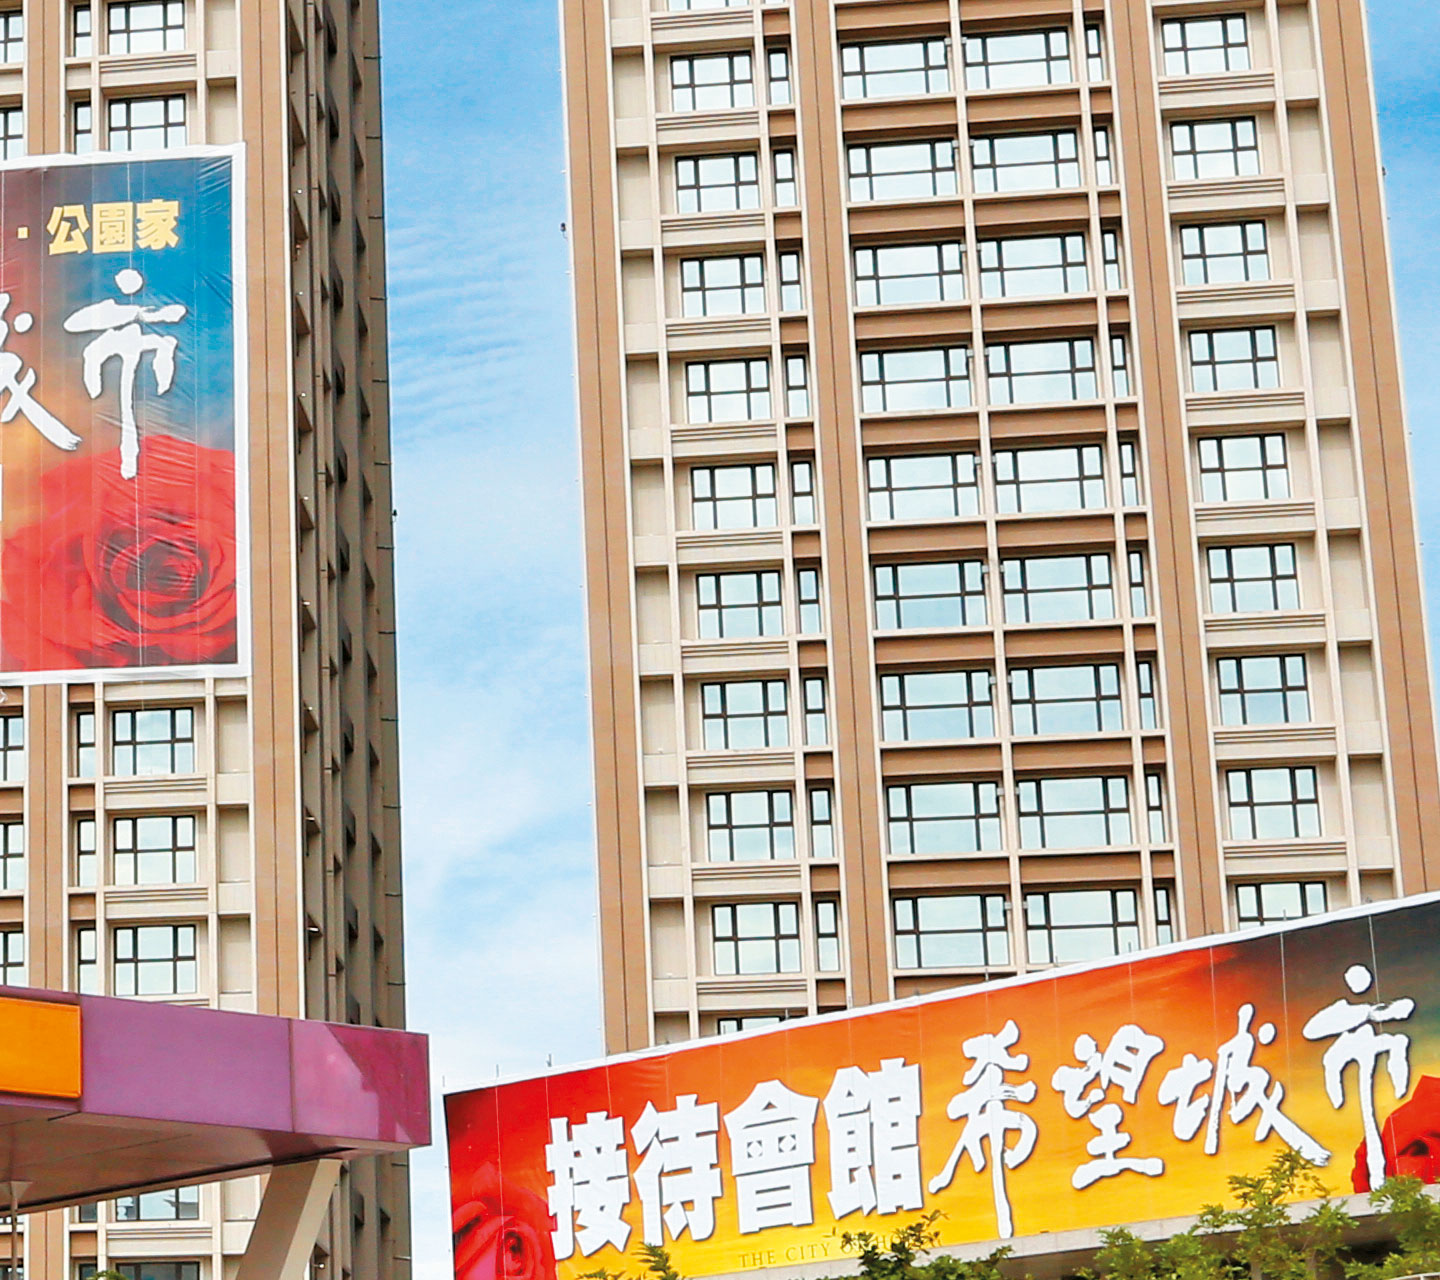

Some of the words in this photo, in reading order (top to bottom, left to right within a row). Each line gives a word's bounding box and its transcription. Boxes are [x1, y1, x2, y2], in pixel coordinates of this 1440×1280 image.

[544, 1056, 924, 1262] 接待會館
[928, 963, 1416, 1239] 希望城市
[738, 1250, 778, 1269] THE
[785, 1242, 832, 1262] CITY
